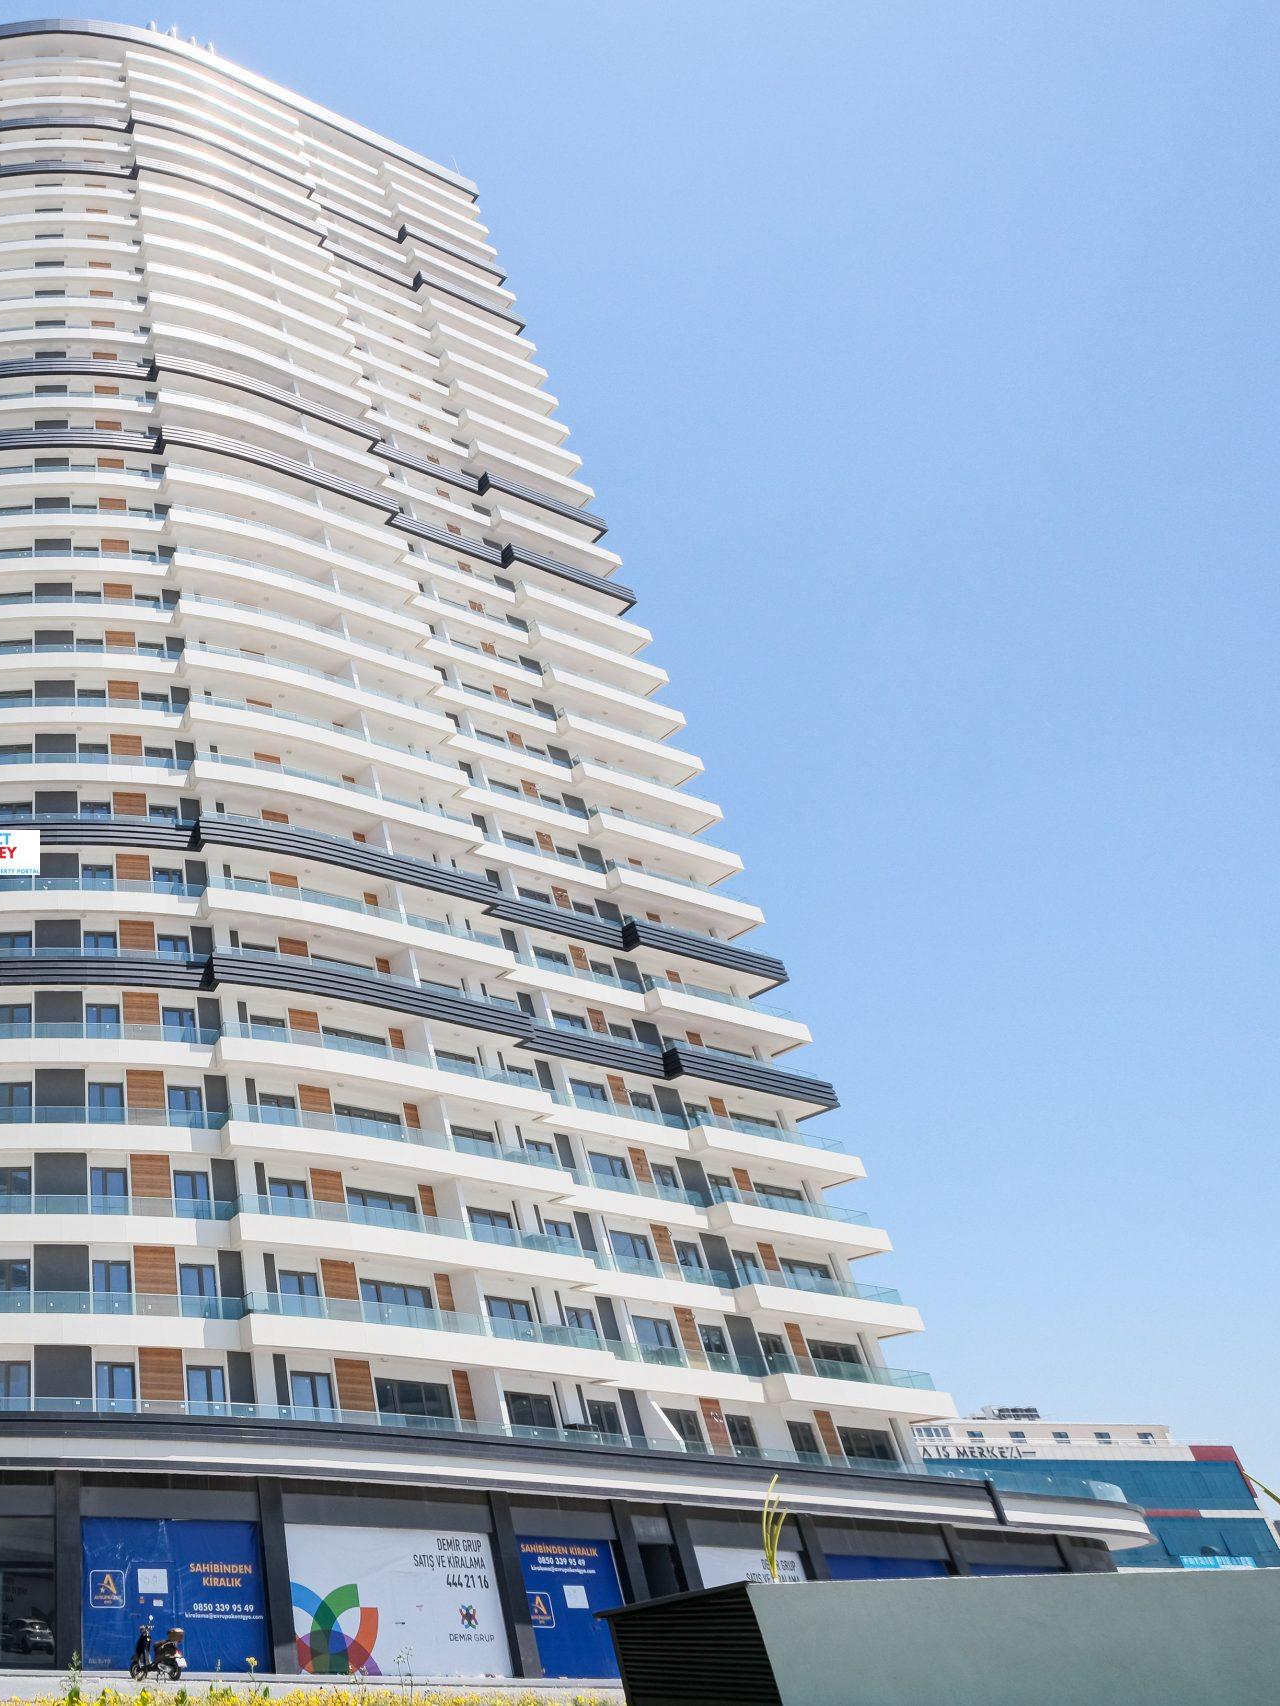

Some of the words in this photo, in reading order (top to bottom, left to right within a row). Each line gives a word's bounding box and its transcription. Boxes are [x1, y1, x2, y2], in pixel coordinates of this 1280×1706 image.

[436, 1536, 461, 1551] DEMİR
[462, 1539, 482, 1552] GRUP
[520, 1543, 568, 1555] SAHİBİNDEN
[569, 1546, 598, 1557] KİRALIK
[413, 1554, 434, 1571] SATIŞ
[435, 1555, 446, 1568] VE
[447, 1554, 486, 1570] KİRALAMA
[537, 1556, 554, 1564] 0850
[555, 1557, 567, 1565] 339
[568, 1558, 577, 1566] 95
[577, 1559, 586, 1567] 49
[189, 1562, 253, 1574] SAHİBİNDEN
[202, 1575, 242, 1587] KİRALIK
[446, 1574, 463, 1588] 444
[464, 1574, 476, 1588] 21
[478, 1575, 489, 1588] 16
[193, 1603, 213, 1612] 0850
[215, 1603, 230, 1612] 339
[232, 1604, 242, 1612] 95
[244, 1604, 254, 1612] 49
[474, 1634, 495, 1642] GRUP
